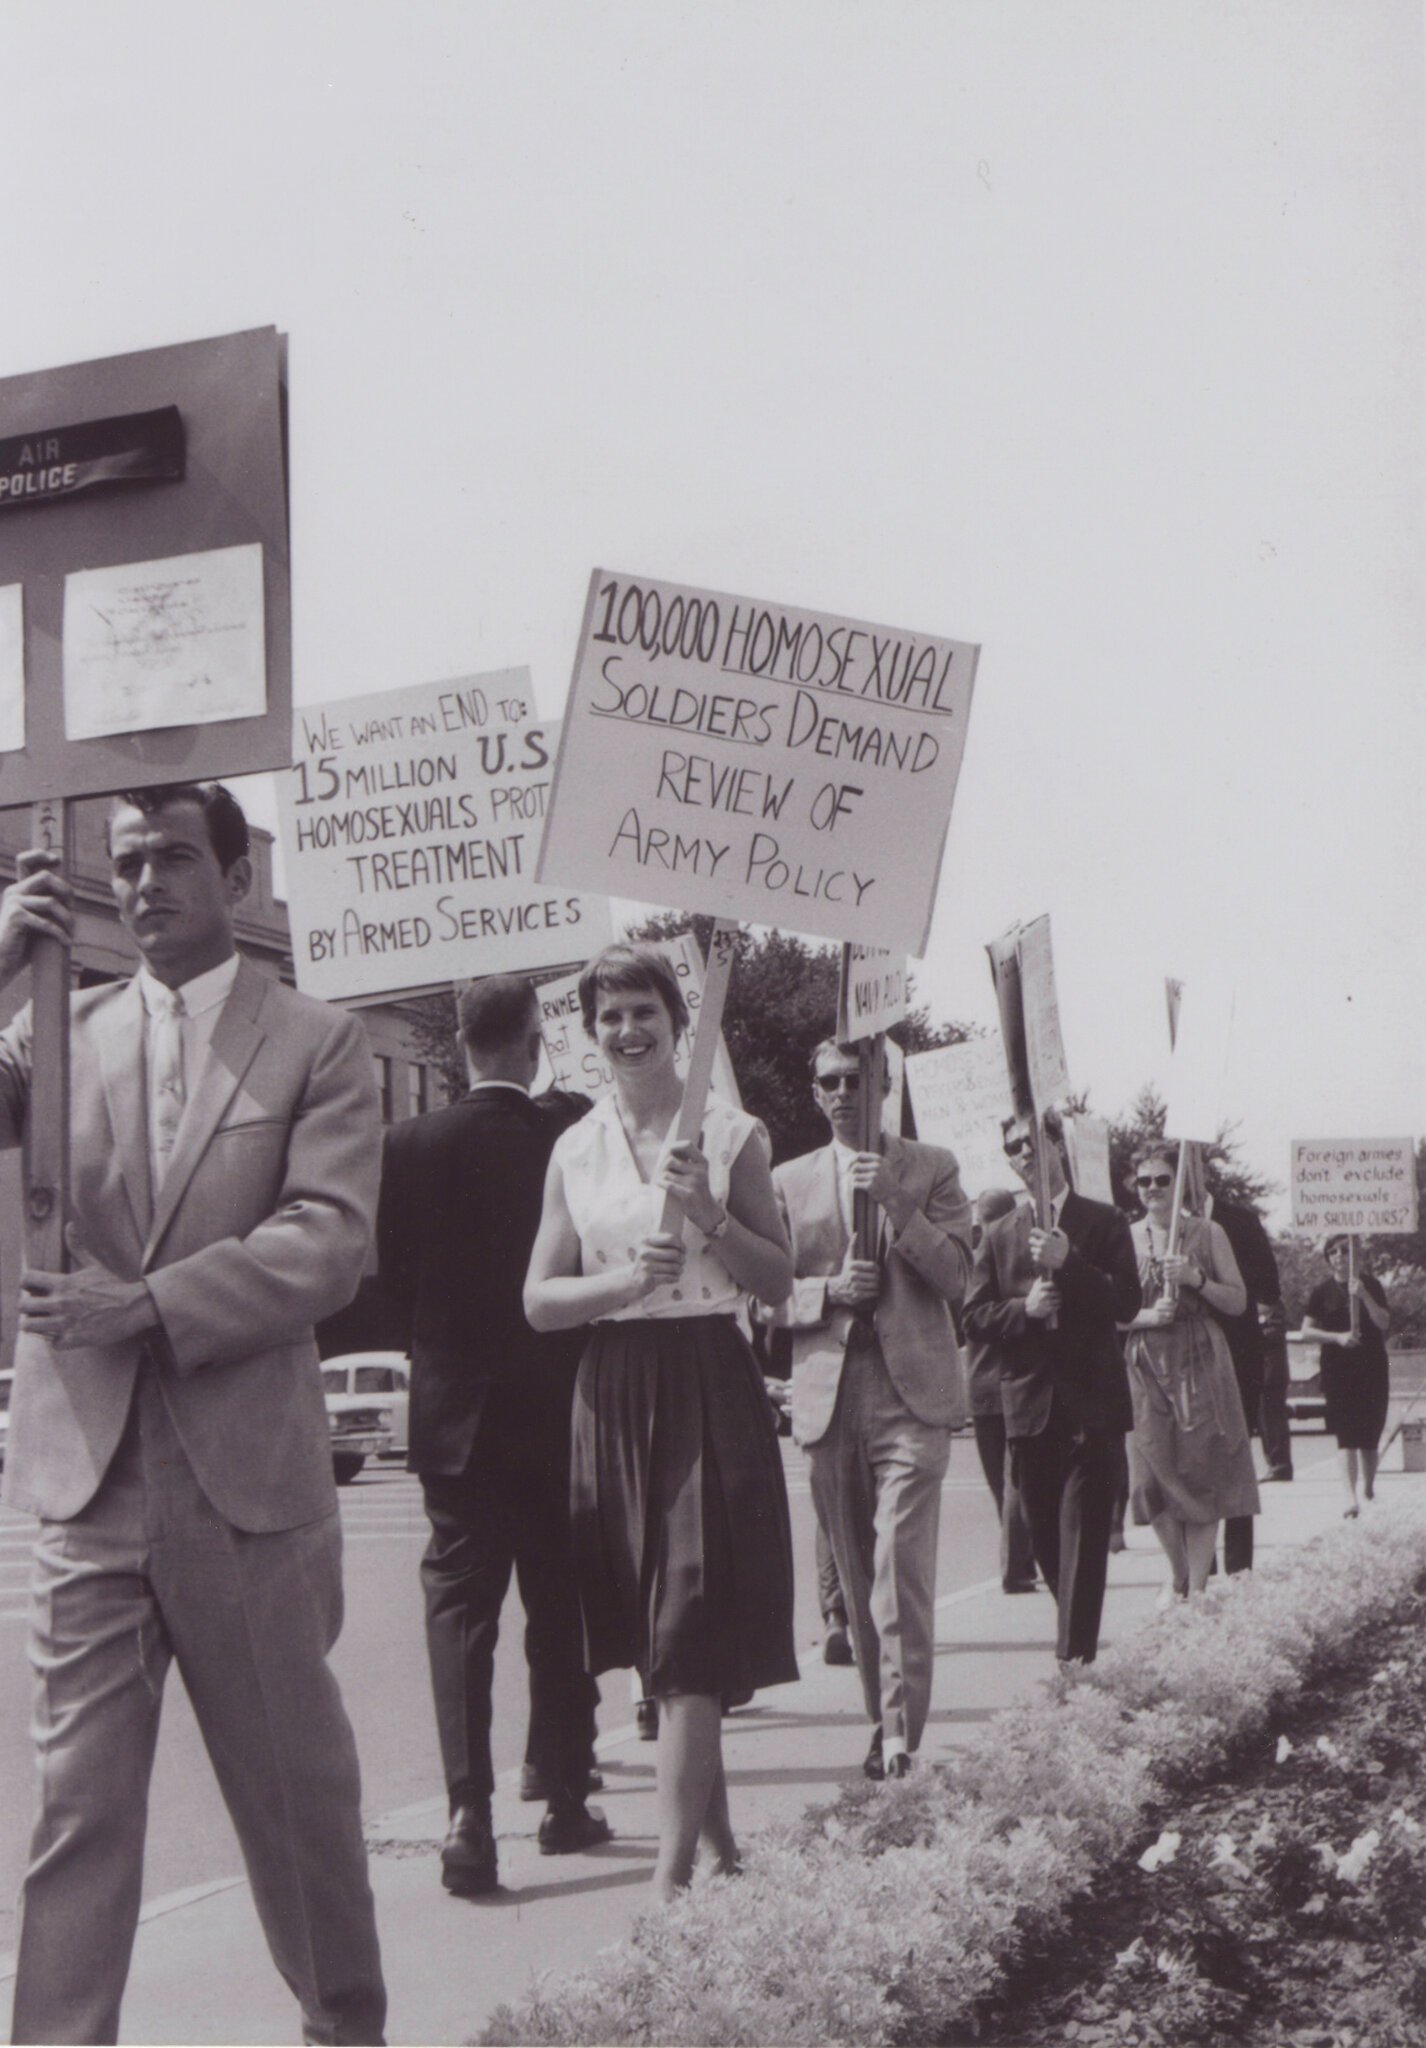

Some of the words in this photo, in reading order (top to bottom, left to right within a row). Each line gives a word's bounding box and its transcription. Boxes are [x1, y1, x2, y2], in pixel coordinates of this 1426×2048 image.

[0, 462, 78, 499] POLICE
[18, 438, 60, 467] AIR
[593, 581, 720, 664] 100,000
[722, 603, 954, 714] HOMOSEXUAL
[350, 716, 403, 746] WANT
[410, 713, 437, 736] AN
[438, 688, 490, 732] END
[496, 699, 528, 724] TO:
[590, 656, 779, 744] SOLDIERS
[786, 690, 940, 773] DEMAND
[292, 757, 341, 805] 15
[346, 755, 457, 799] MILLION
[656, 750, 794, 821] REVIEW
[810, 783, 864, 832] OF
[296, 794, 478, 852] HOMOSEXUALS
[347, 834, 525, 893] TREATMENT
[608, 807, 730, 877] ARMY
[745, 832, 876, 907] POLICY
[309, 929, 337, 962] BY
[343, 908, 431, 957] ARMED
[436, 896, 582, 942] SERVICES
[1297, 1146, 1355, 1168] Foreign
[1344, 1165, 1405, 1182] exclude
[1295, 1212, 1318, 1227] WHY
[1324, 1210, 1364, 1227] SHOULD
[1367, 1206, 1410, 1227] OURS?
